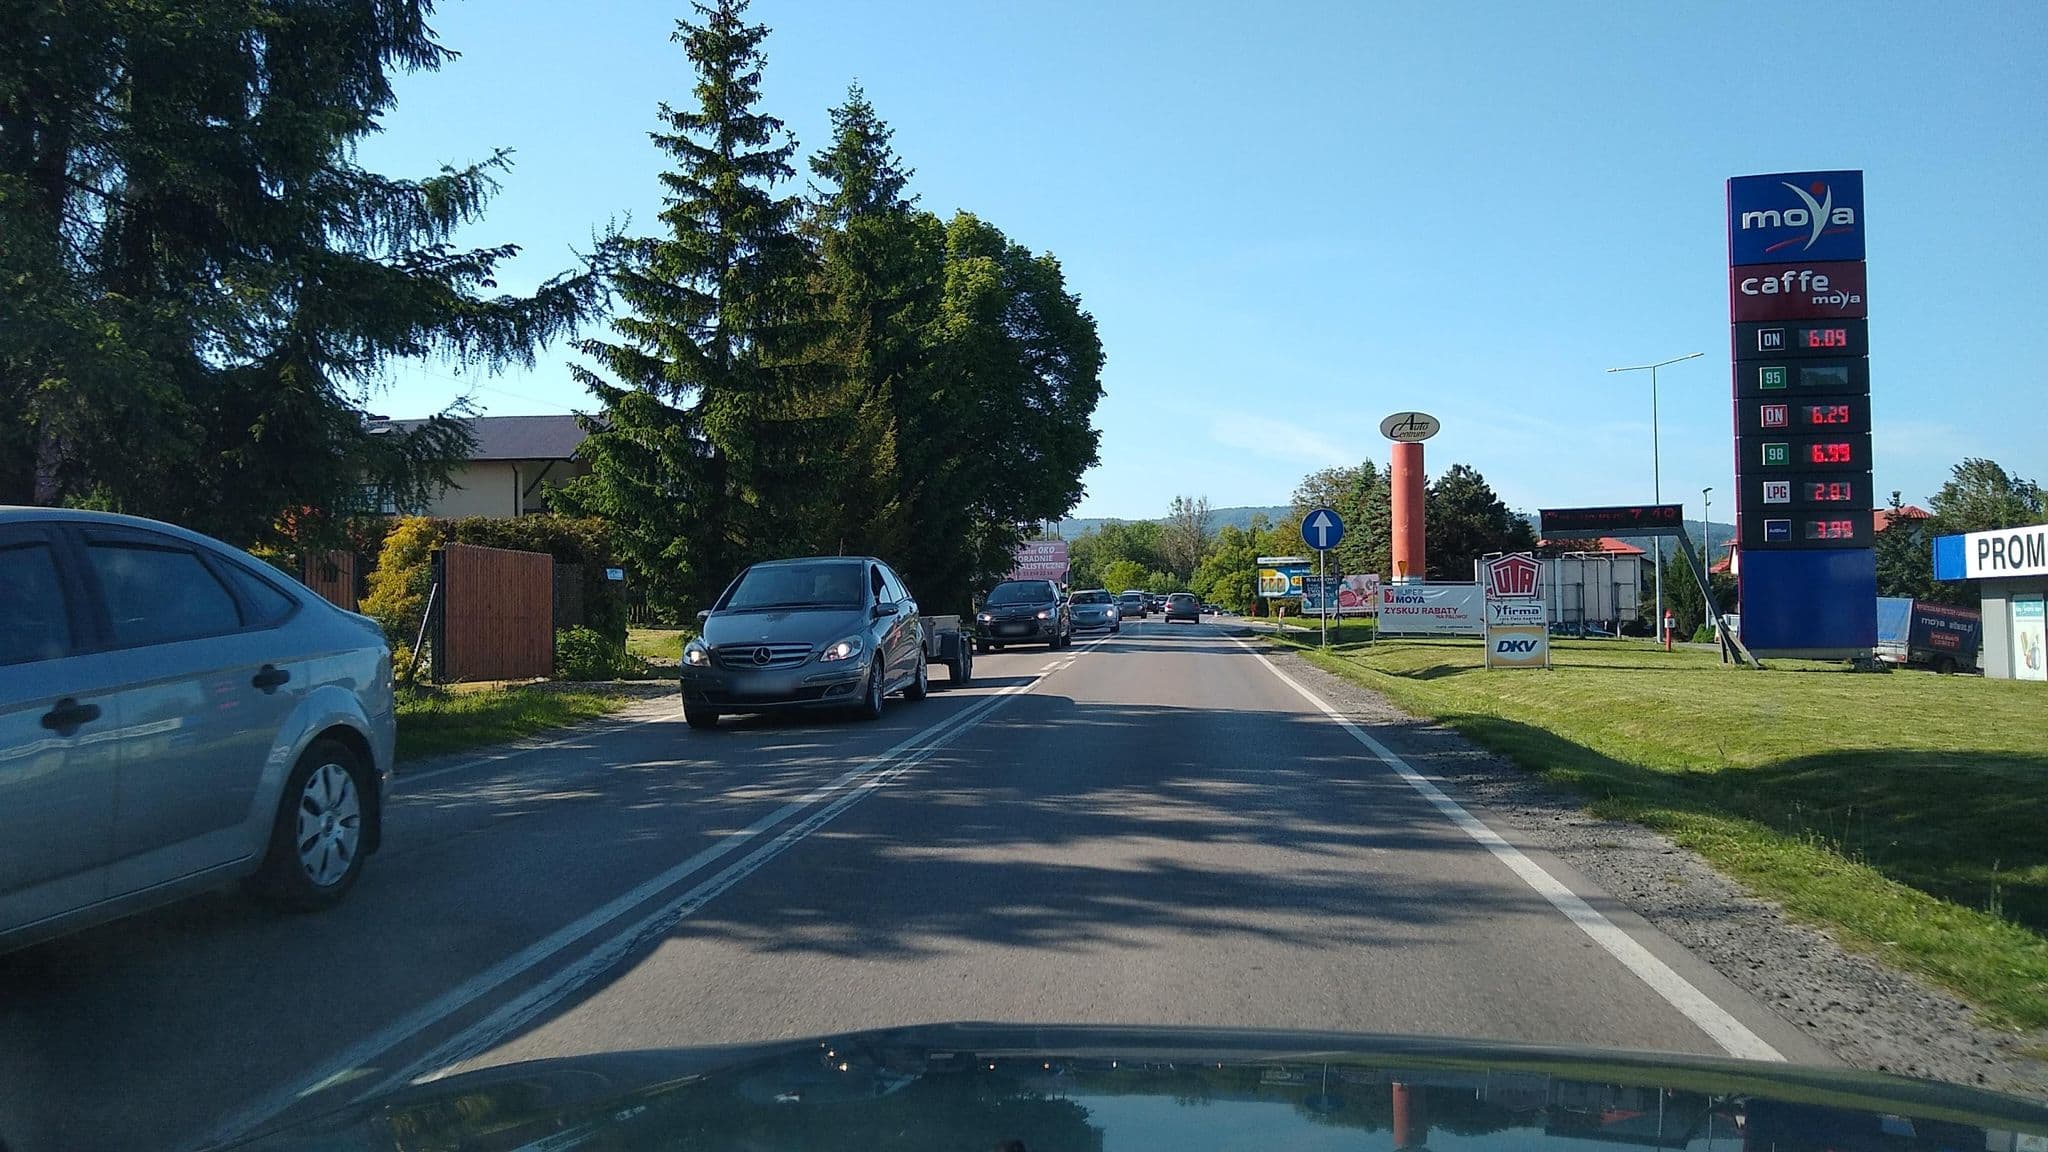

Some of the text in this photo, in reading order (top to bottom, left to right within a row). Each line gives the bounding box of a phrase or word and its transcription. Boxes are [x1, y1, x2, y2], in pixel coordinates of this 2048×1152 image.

[1742, 182, 1855, 251] moya
[1741, 270, 1829, 295] caffe
[1812, 290, 1861, 310] moya
[1764, 329, 1846, 348] ON 6.09
[1766, 371, 1781, 384] 95
[1812, 405, 1849, 424] 6.29
[1769, 443, 1851, 463] 98 6.99
[1767, 486, 1787, 499] LPG
[1038, 546, 1055, 554] OKO
[1978, 532, 2046, 571] PROM
[1021, 562, 1065, 570] ALISTYCZNE
[1395, 596, 1425, 604] MOYA
[1385, 607, 1459, 615] ZYSKUJ RABATY
[1497, 640, 1538, 653] DKV
